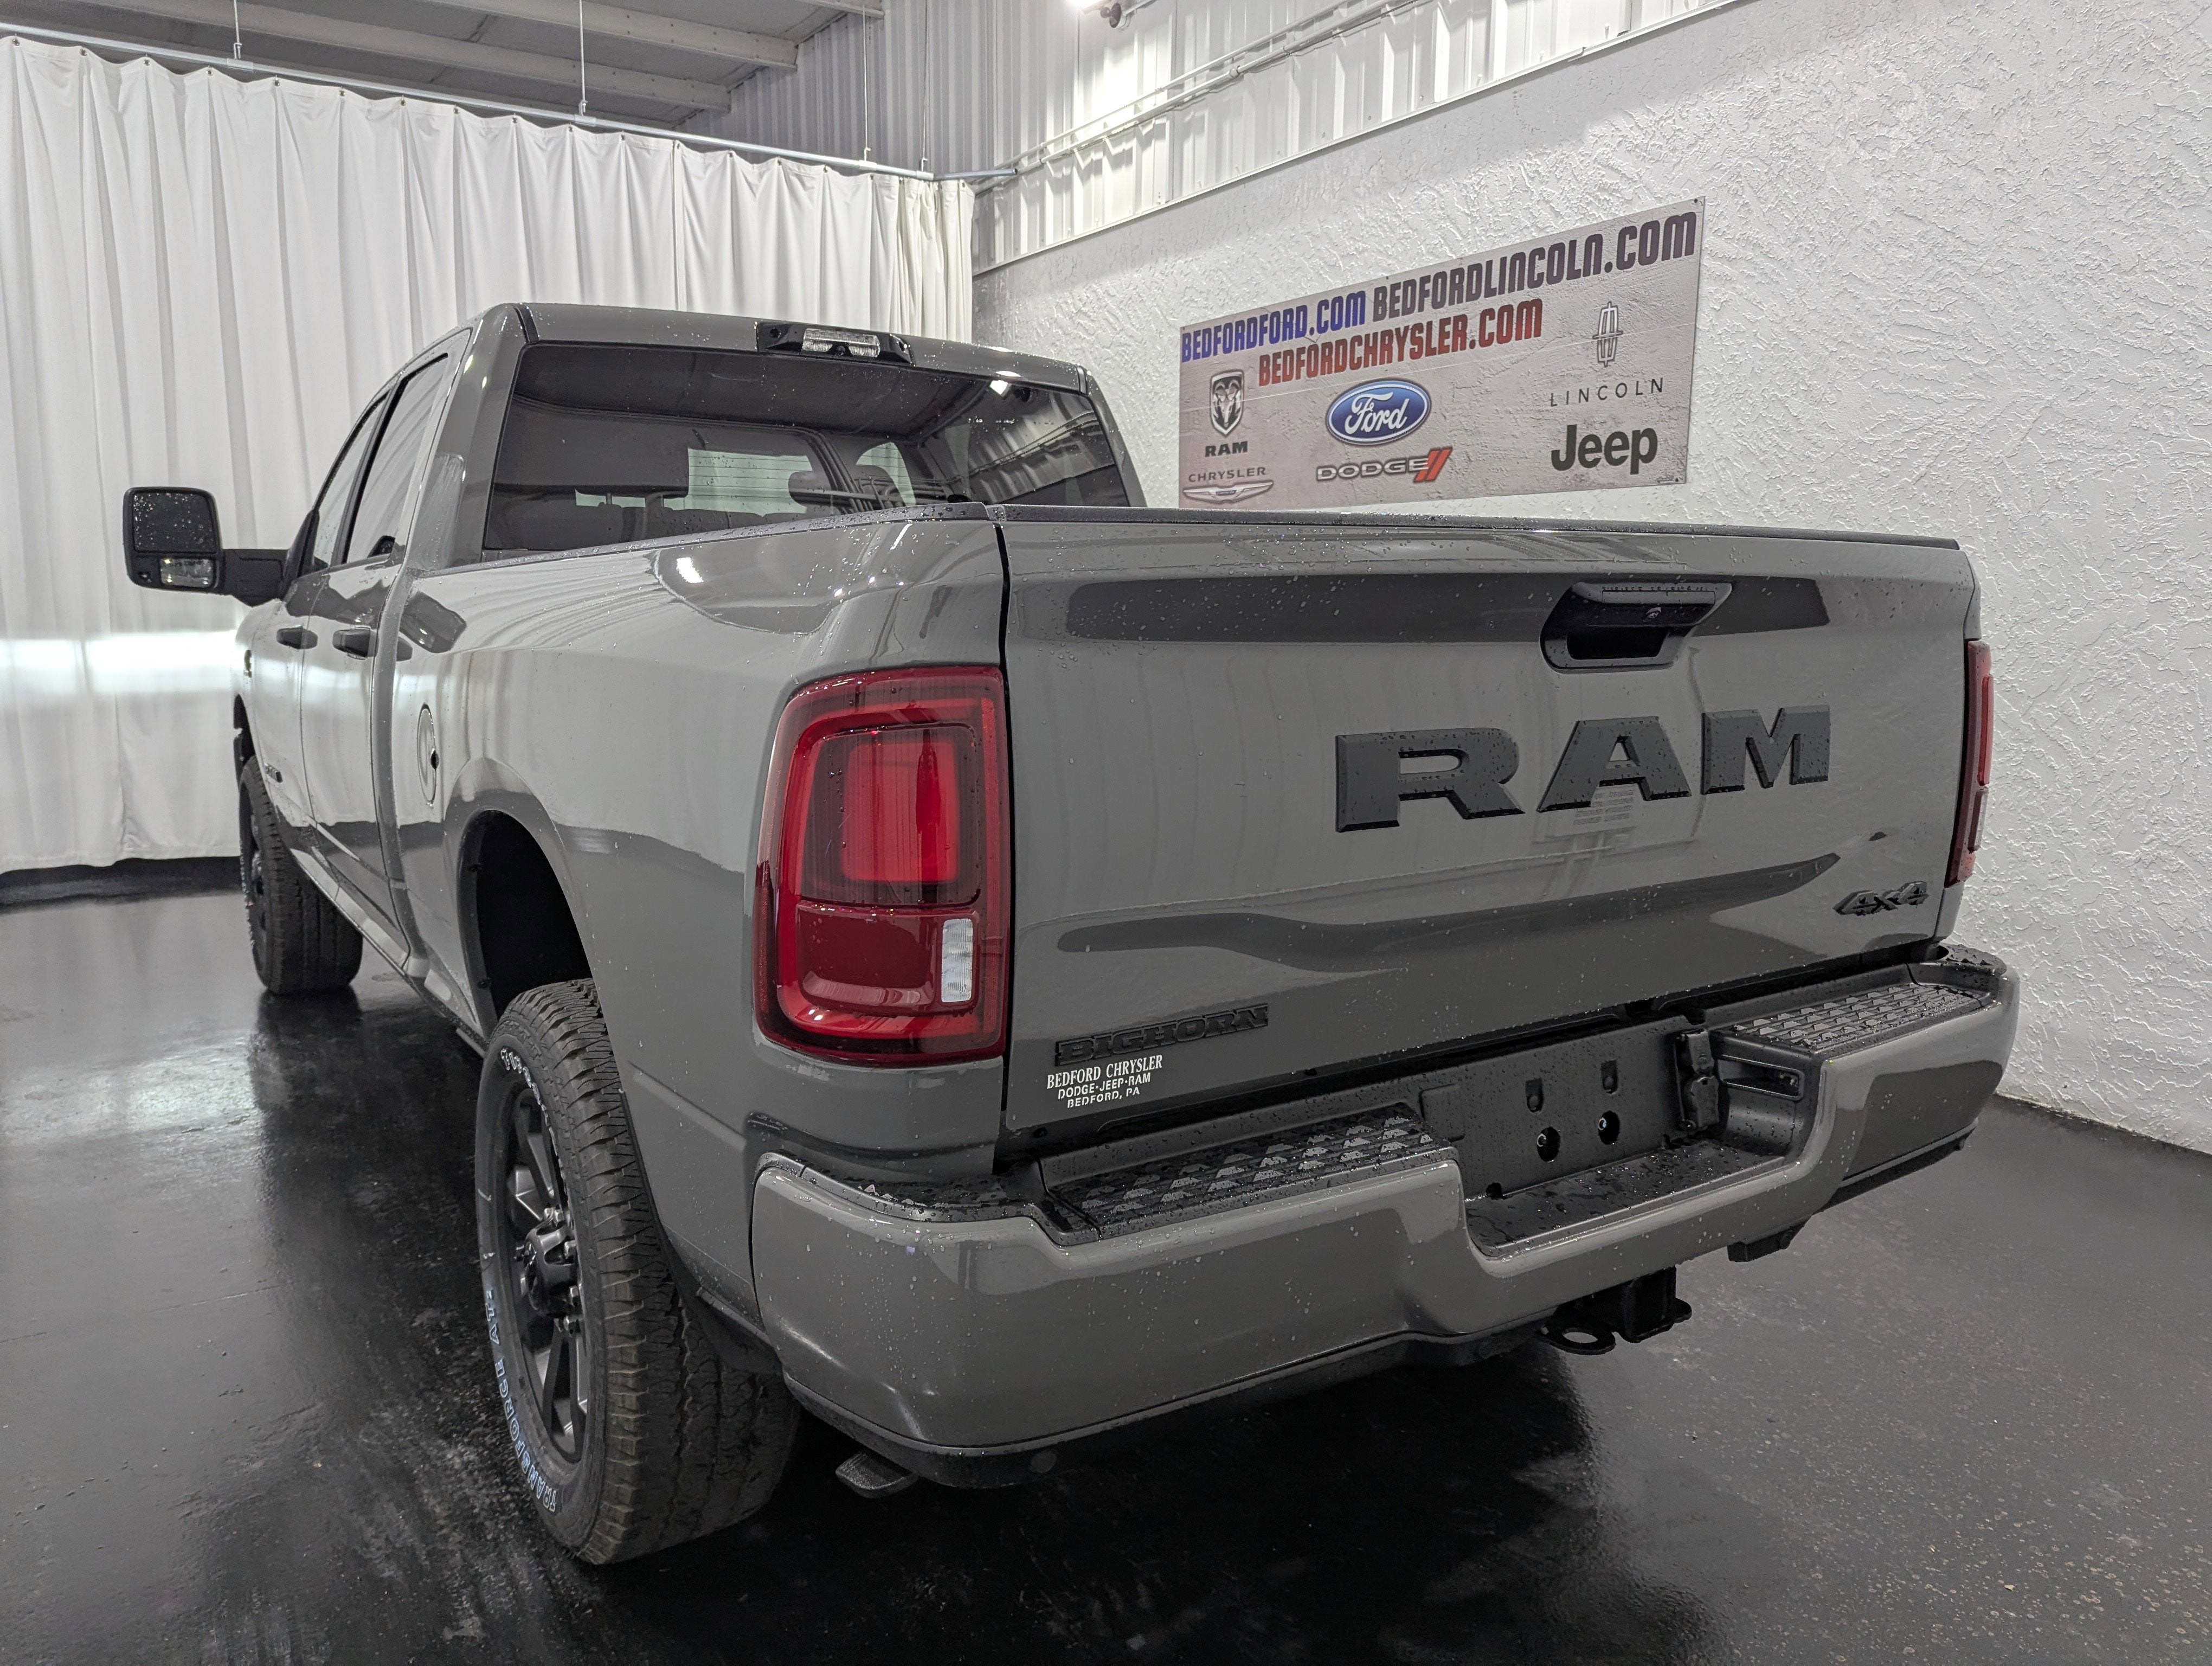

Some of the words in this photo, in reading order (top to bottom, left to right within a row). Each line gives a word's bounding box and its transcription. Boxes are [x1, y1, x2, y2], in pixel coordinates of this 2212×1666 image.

[1181, 291, 1366, 363] BEDFORDFORD.COM
[1373, 212, 1697, 322] BEDFORDLINCOLN.COM
[1259, 298, 1543, 387] BEDFORDCHRYSLER.COM
[1551, 377, 1663, 407] LINCOLN
[1345, 392, 1409, 434] Ford
[1205, 441, 1248, 457] RAM
[1551, 424, 1658, 475] Jeep
[1188, 467, 1266, 482] CHRYSLER
[1316, 457, 1430, 482] DODGE
[1336, 704, 1830, 833] RAM
[1046, 1066, 1101, 1090] BEDFORD
[1106, 1054, 1163, 1078] CHRYSLER
[1067, 1091, 1123, 1108] BEDFORD,
[1126, 1086, 1140, 1097] PA
[494, 1357, 558, 1513] TRANSFORCE
